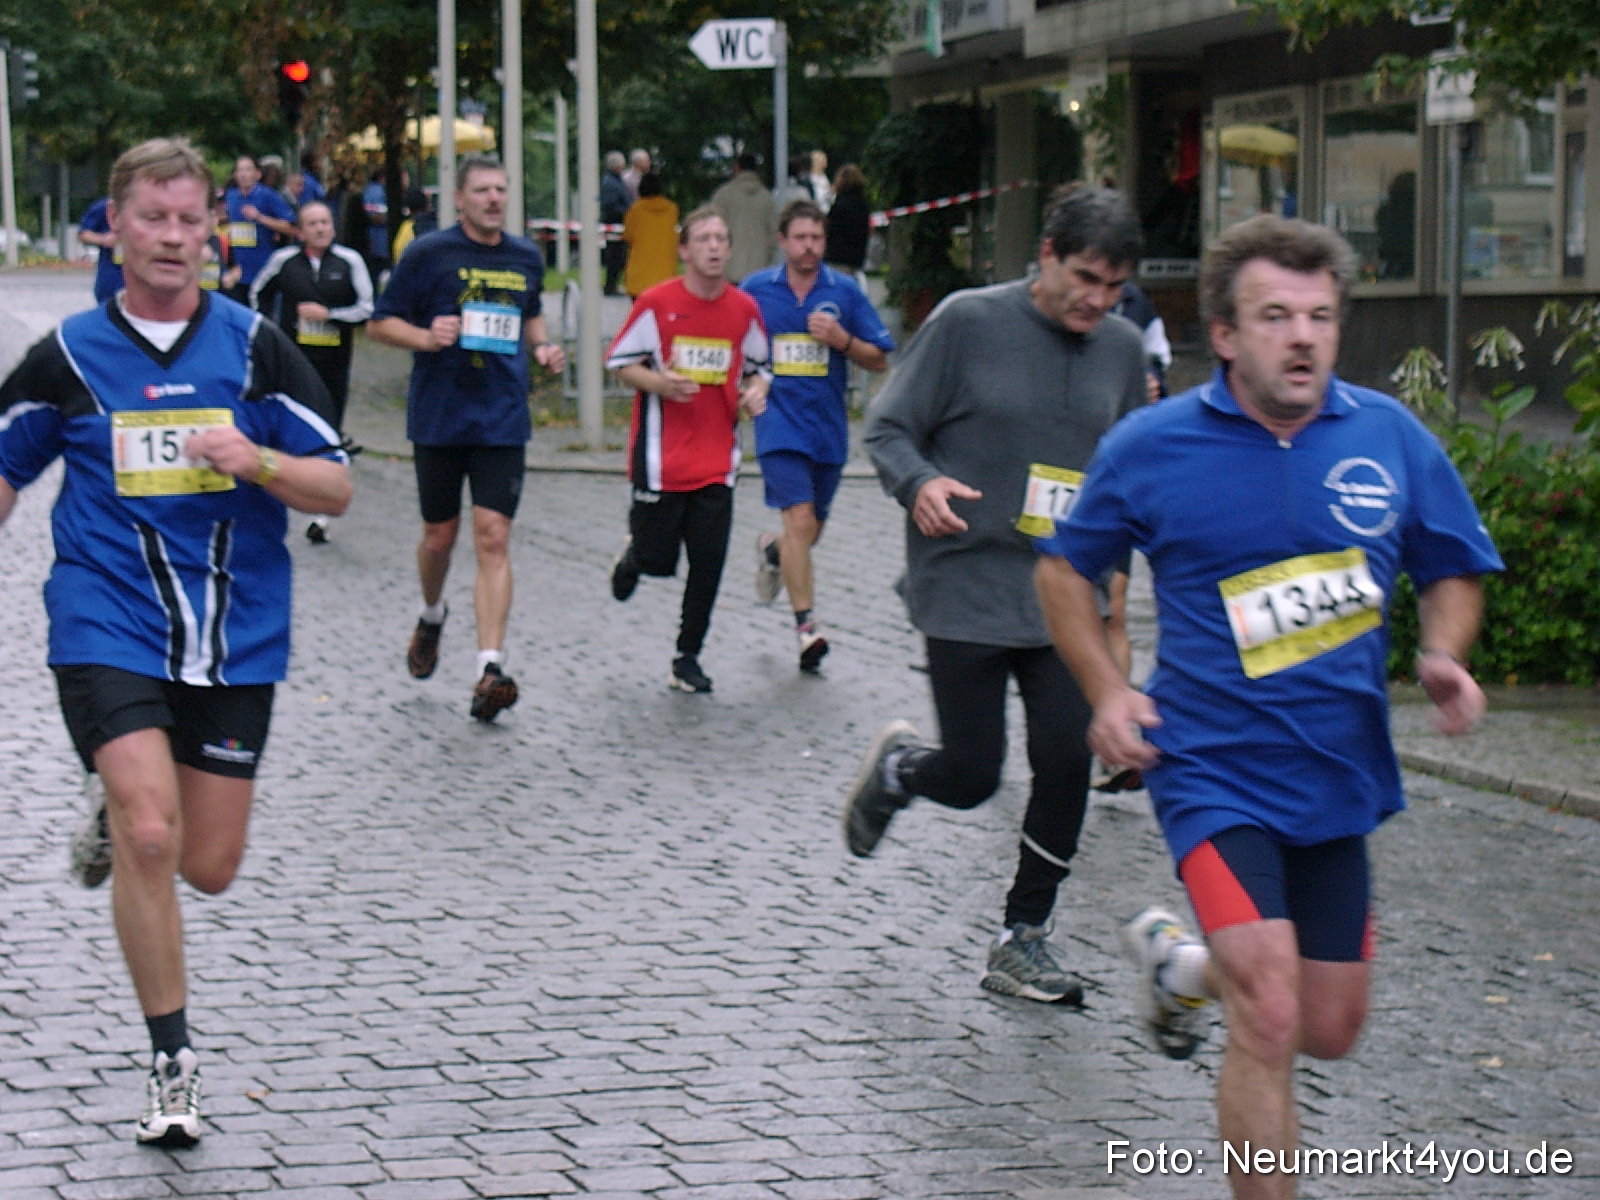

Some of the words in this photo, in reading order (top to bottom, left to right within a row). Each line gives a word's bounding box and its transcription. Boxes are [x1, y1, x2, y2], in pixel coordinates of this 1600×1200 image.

[716, 27, 763, 60] WC
[686, 348, 726, 369] 1540
[1257, 574, 1367, 634] 1344
